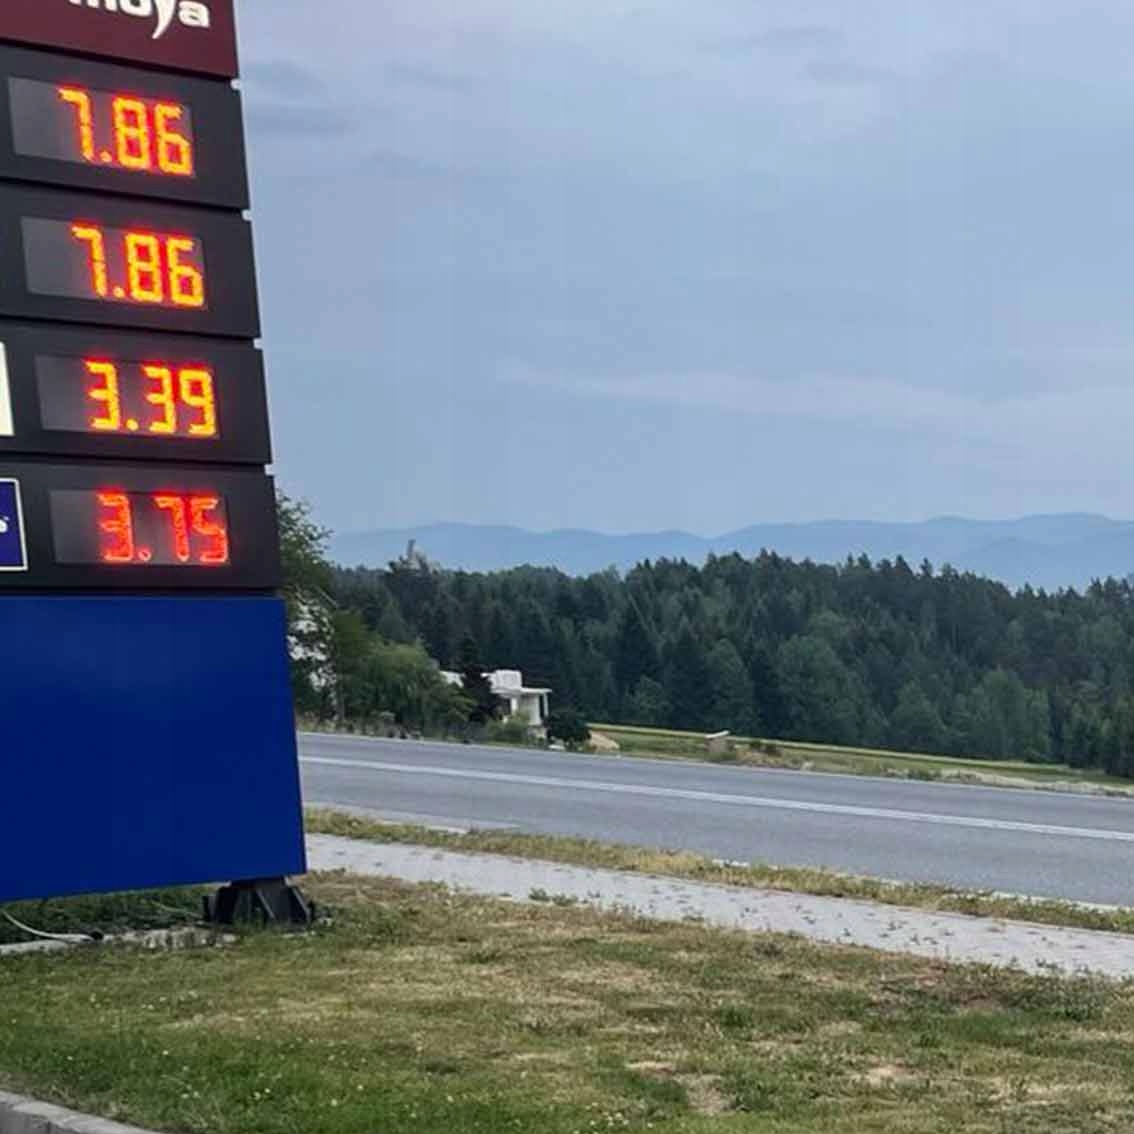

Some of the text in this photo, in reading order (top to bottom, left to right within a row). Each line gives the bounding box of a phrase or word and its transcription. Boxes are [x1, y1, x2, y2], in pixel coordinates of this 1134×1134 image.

[57, 86, 195, 175] 7.86
[70, 224, 205, 307] 7.86
[84, 360, 217, 437] 3.39
[96, 492, 229, 563] 3.75
